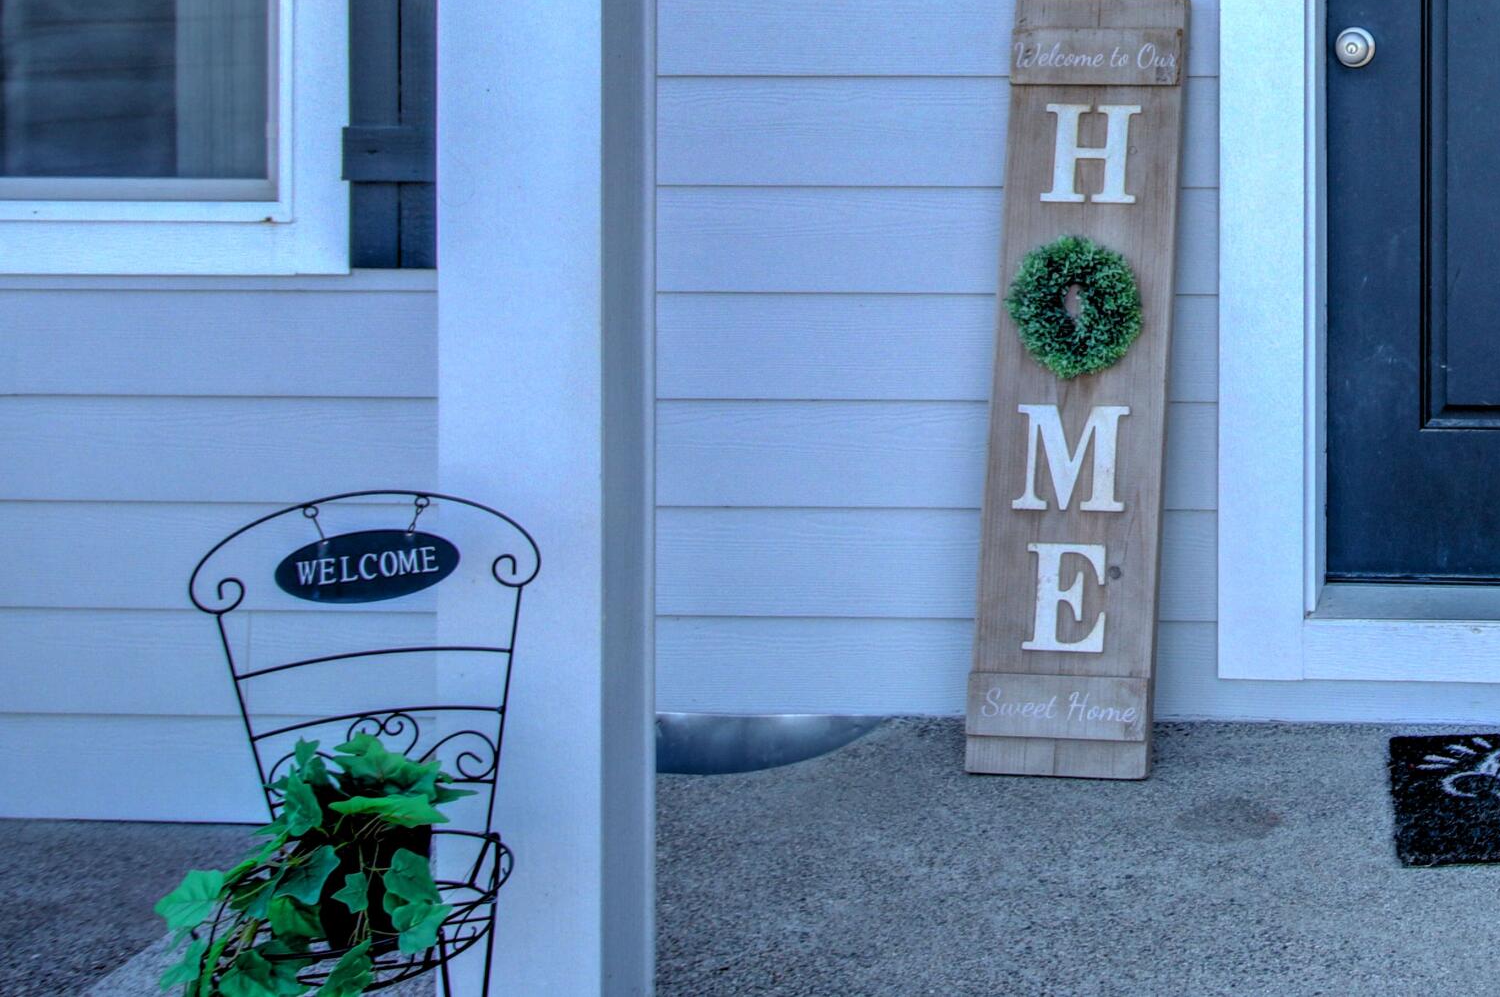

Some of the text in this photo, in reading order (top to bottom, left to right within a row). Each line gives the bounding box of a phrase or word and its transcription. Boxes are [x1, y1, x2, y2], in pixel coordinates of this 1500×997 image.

[1013, 41, 1176, 70] Welcome to Our
[296, 546, 440, 586] WELCOME
[981, 687, 1137, 724] Sweet Home
